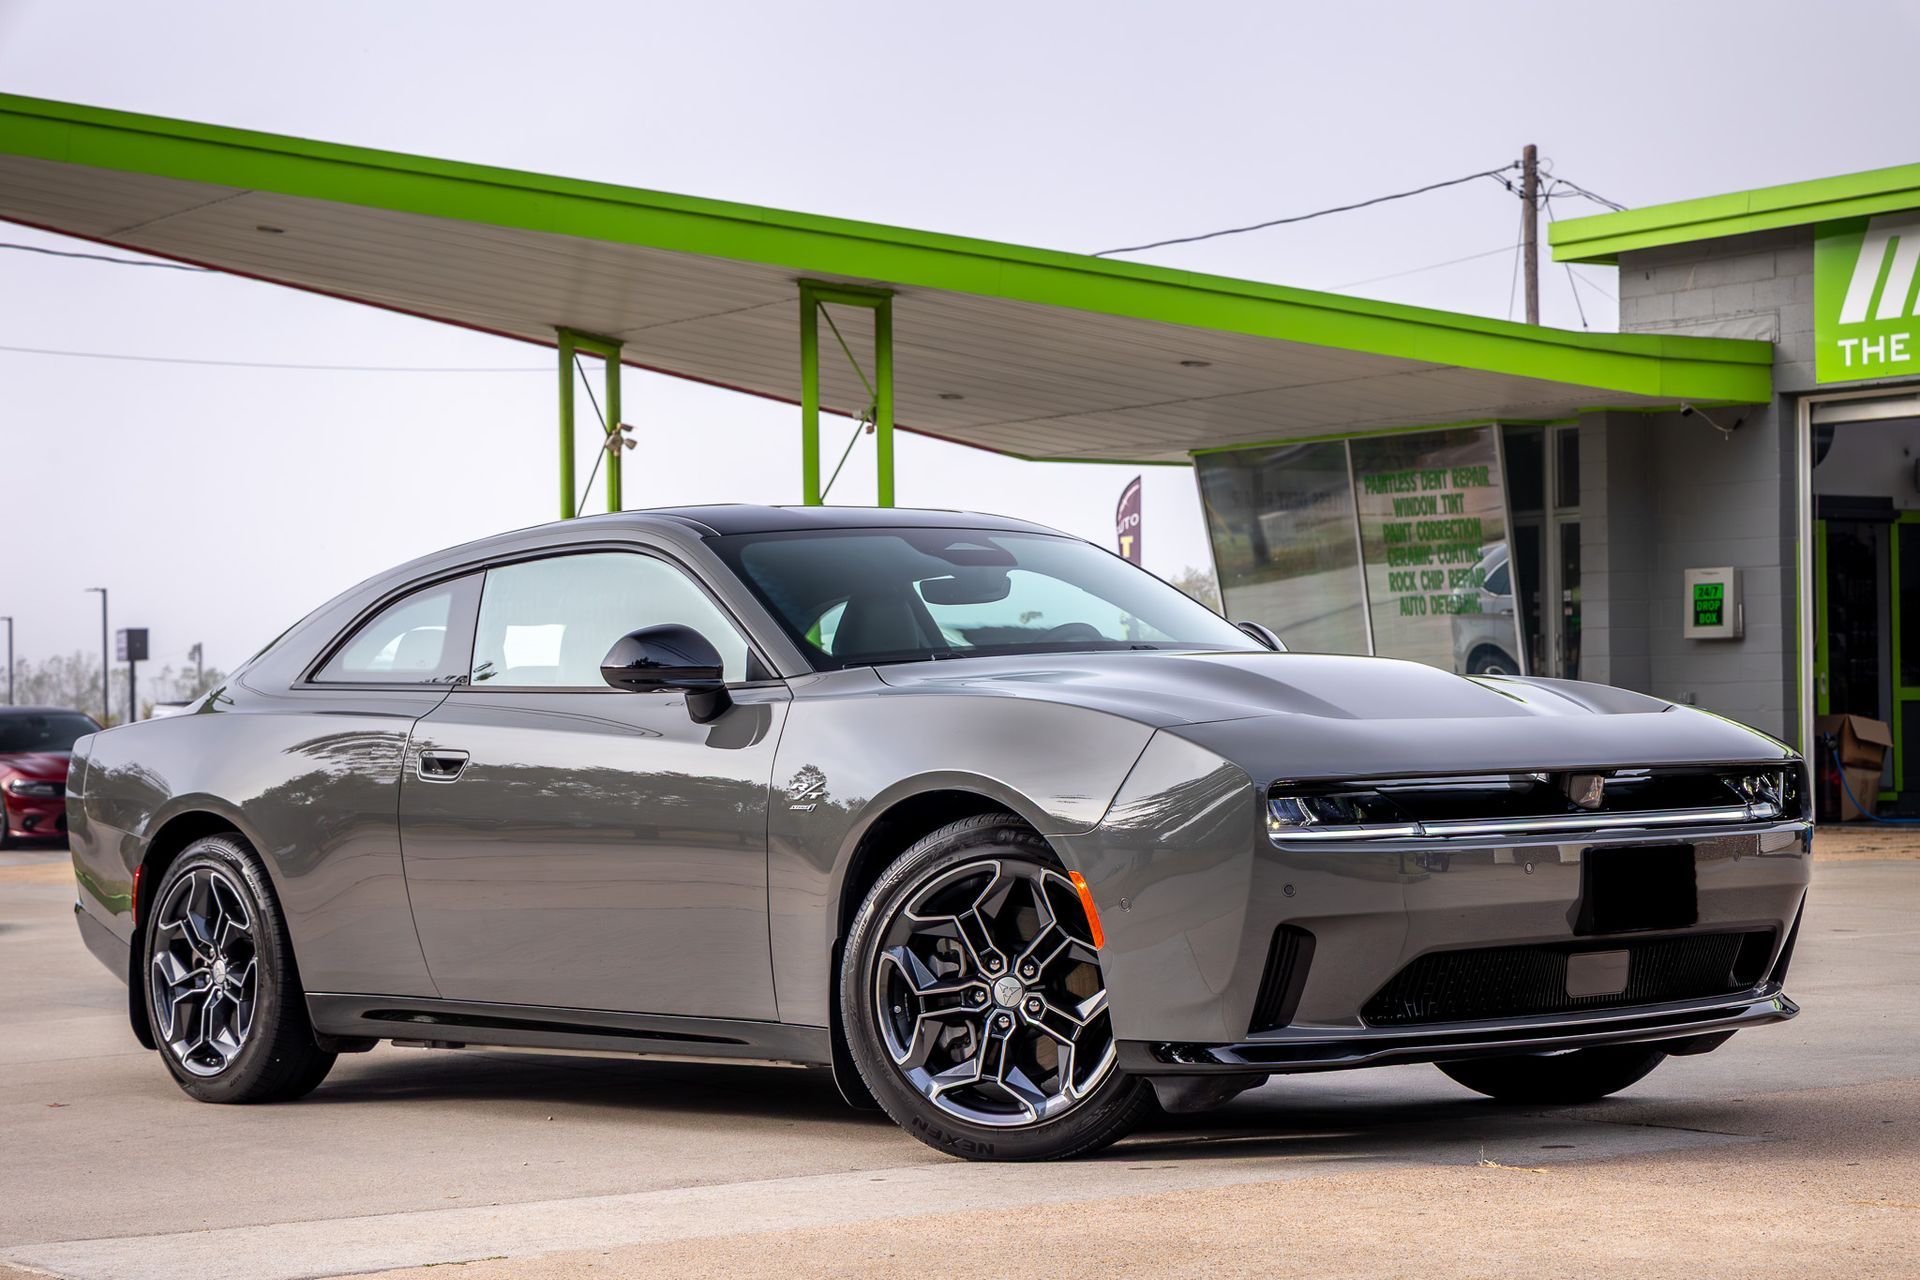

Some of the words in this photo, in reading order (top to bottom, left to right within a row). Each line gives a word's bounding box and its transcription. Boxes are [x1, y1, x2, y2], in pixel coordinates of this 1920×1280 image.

[1837, 332, 1911, 367] THE
[1363, 470, 1417, 495] PAINTLESS
[1420, 469, 1448, 491] DENT
[1451, 465, 1490, 488] REPAIR
[1392, 495, 1438, 518] WINDOW
[1440, 493, 1464, 514] TINT
[1117, 512, 1140, 535] UTO
[1382, 522, 1412, 543] PAINT
[1416, 517, 1482, 541] CORRECTION
[1387, 544, 1434, 567] CERAMIC
[1437, 542, 1484, 565] COATING
[1388, 571, 1417, 592] ROCK
[1421, 569, 1444, 591] CHIP
[1448, 567, 1486, 589] REPAIR
[1698, 586, 1719, 597] 24/7
[1400, 595, 1426, 616] AUTO
[1696, 600, 1720, 611] DROP
[1699, 613, 1717, 624] BOX
[911, 1115, 995, 1155] NEXEN
